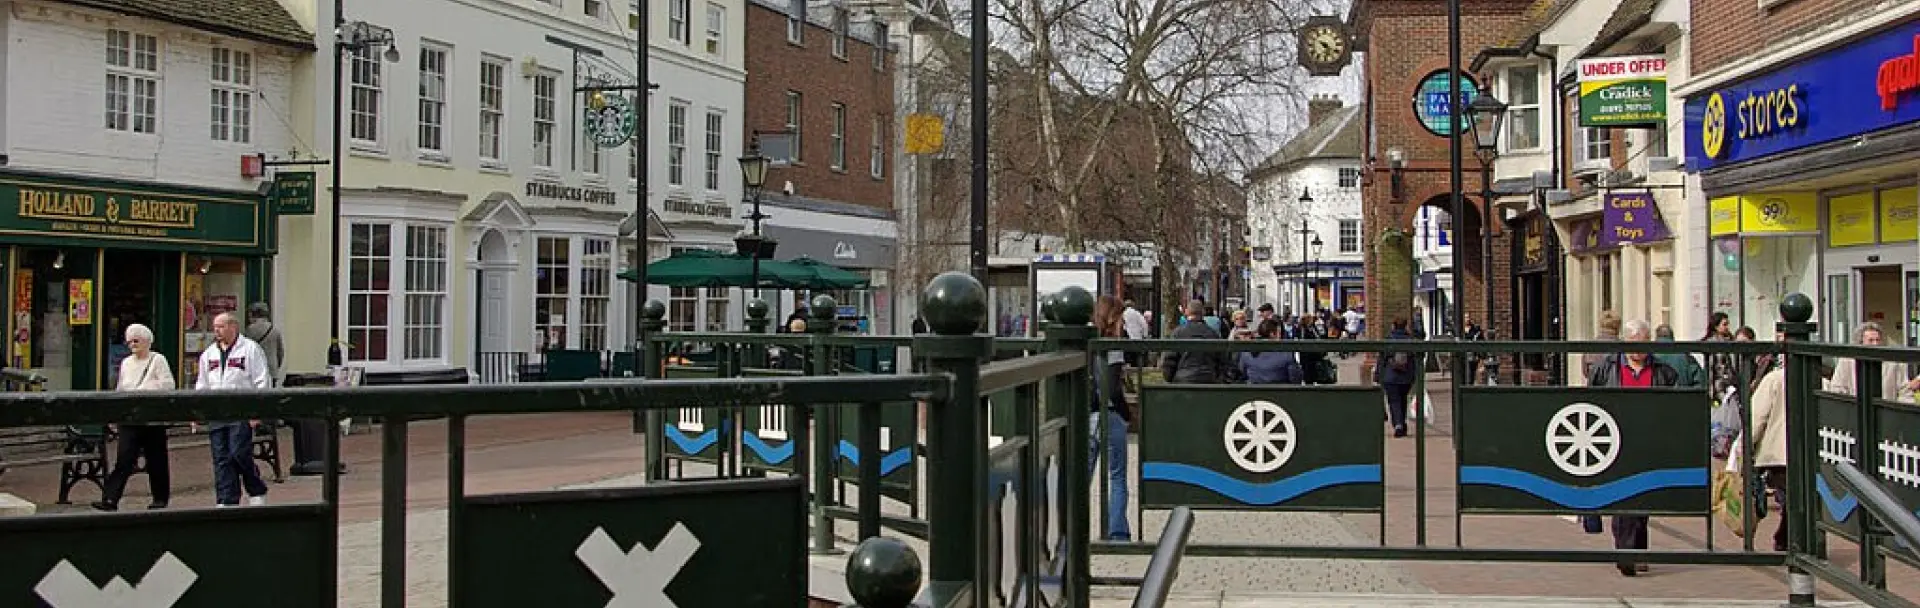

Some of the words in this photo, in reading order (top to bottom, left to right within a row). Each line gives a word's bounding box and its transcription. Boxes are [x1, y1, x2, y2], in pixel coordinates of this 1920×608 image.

[1582, 62, 1625, 76] UNDER
[1600, 85, 1652, 100] Cradick
[1738, 84, 1798, 139] stores
[526, 182, 582, 201] STARBUCKS
[584, 189, 616, 205] COFFEE
[18, 188, 96, 216] HOLLAND
[105, 197, 119, 223] &
[130, 199, 198, 228] BARRETT
[664, 199, 705, 215] STARBUCKS
[1611, 196, 1646, 209] Cards
[1623, 210, 1633, 222] &
[1614, 225, 1644, 239] Toys
